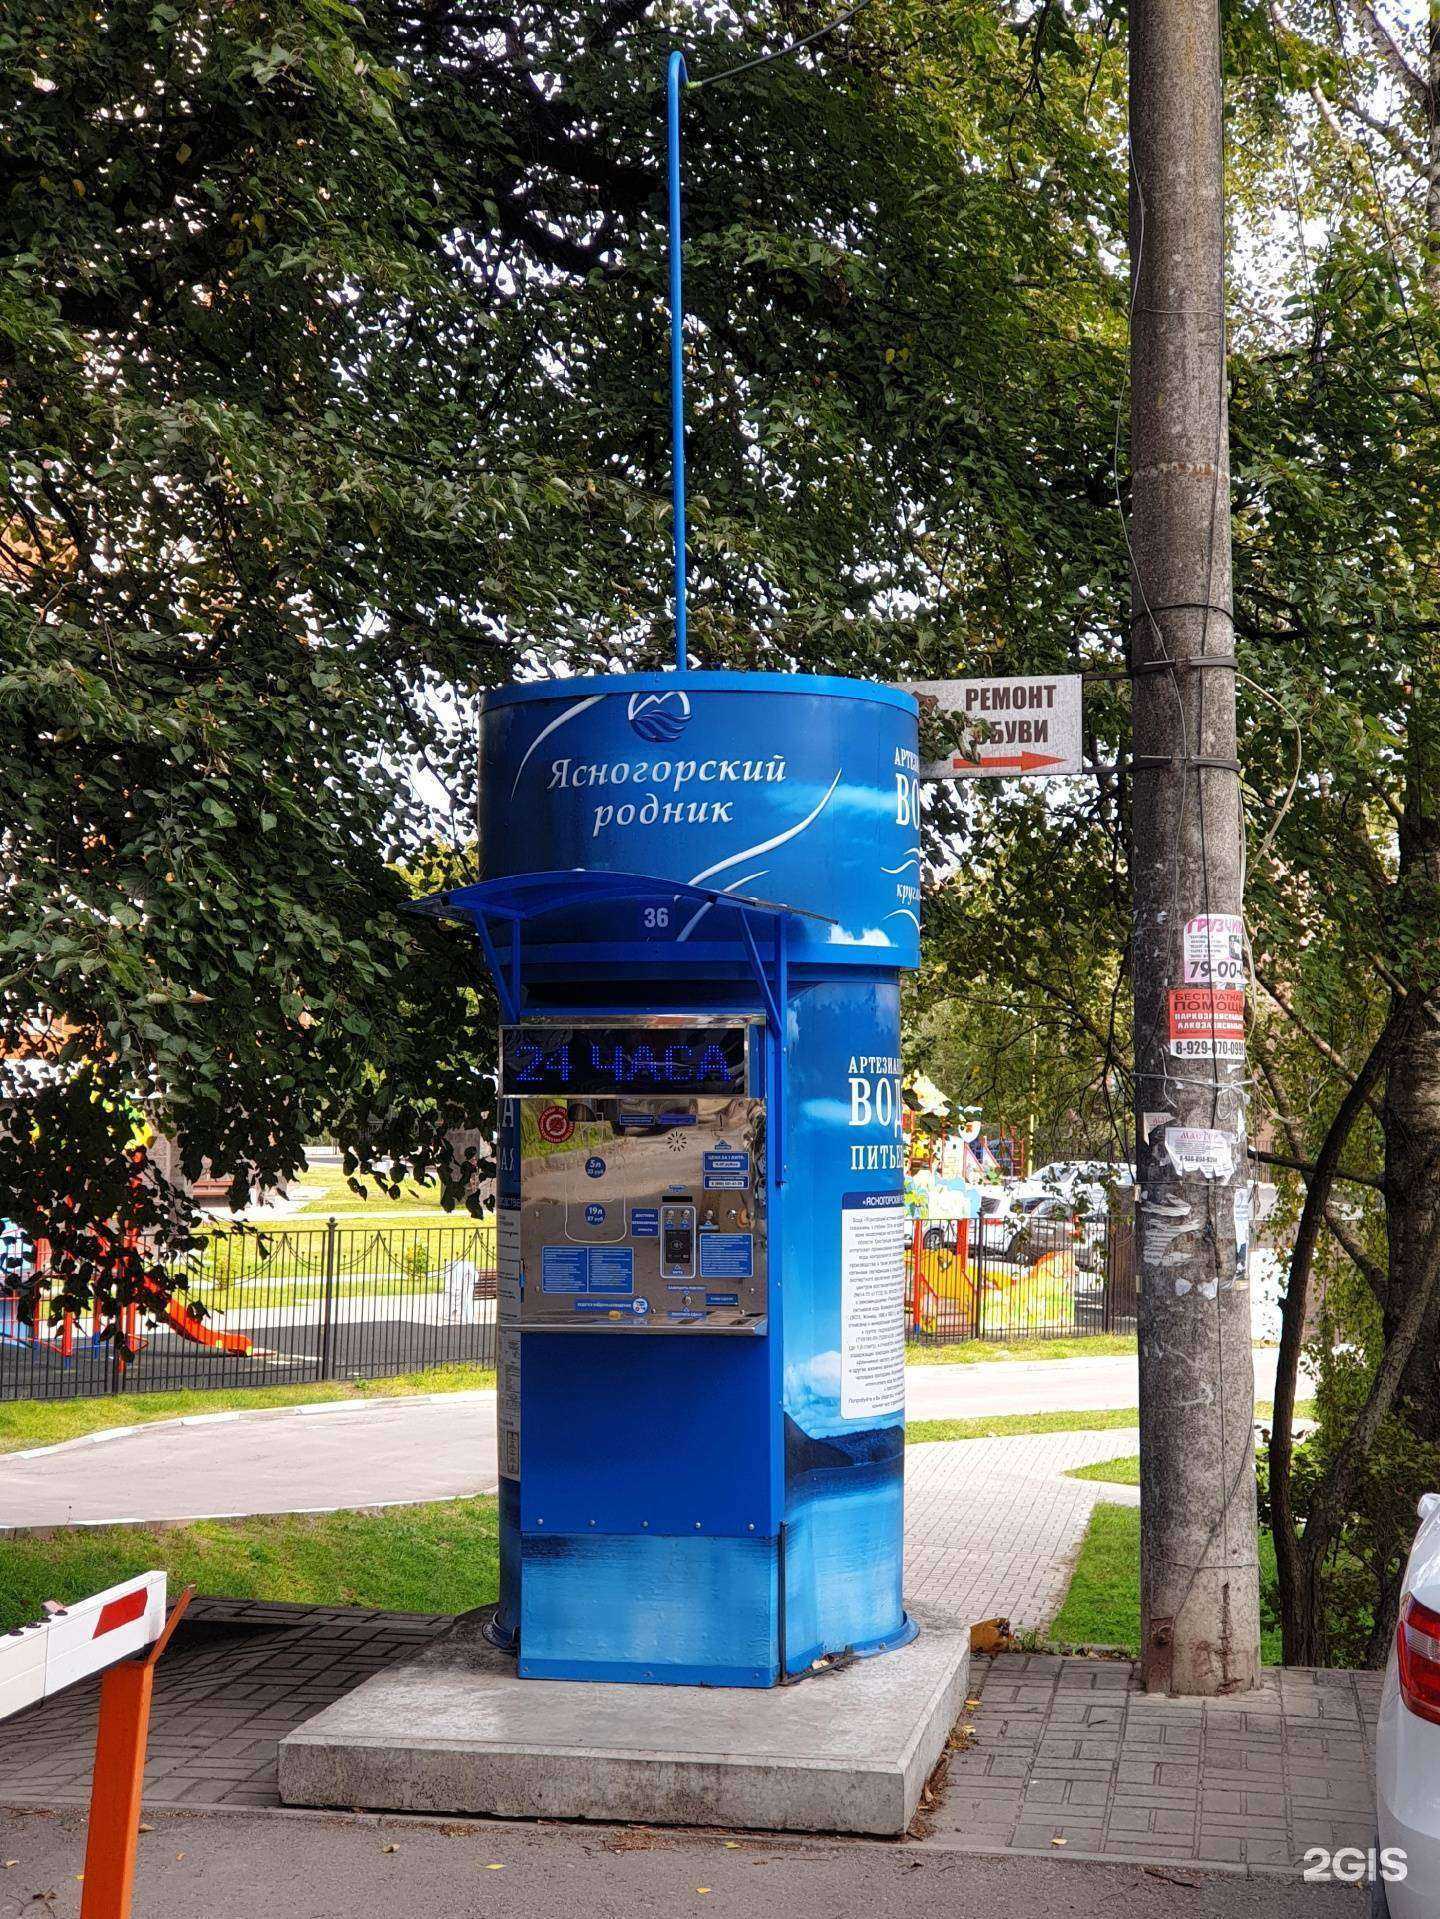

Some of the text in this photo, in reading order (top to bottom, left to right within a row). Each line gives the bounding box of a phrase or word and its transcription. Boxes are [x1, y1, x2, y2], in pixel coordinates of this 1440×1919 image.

[965, 684, 1057, 711] РЕМОНТ
[547, 753, 787, 792] Ясногорский
[592, 792, 734, 837] родник
[643, 907, 669, 928] 36
[1190, 960, 1243, 979] 79-00-
[515, 1045, 732, 1082] 24 ЧАСА
